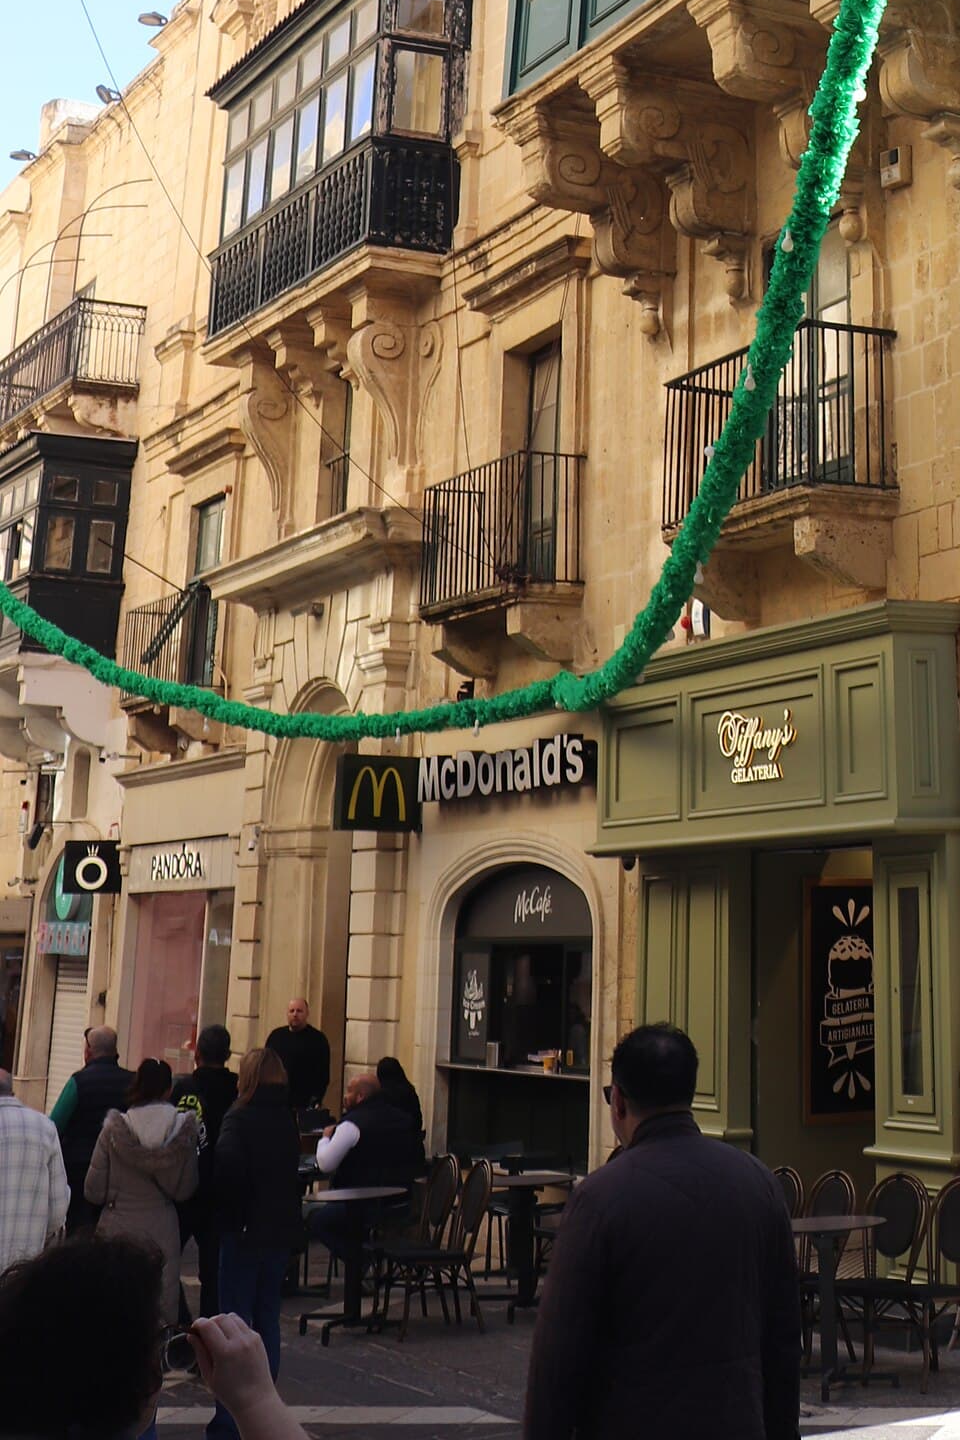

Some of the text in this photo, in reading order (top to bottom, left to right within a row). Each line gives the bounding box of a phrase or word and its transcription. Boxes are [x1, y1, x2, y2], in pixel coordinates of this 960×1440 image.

[717, 708, 796, 768] Tiffany's
[417, 734, 584, 803] McDonald's
[730, 763, 782, 783] GELATERIA
[150, 843, 204, 881] PANDORA
[514, 885, 552, 924] McCafé
[831, 997, 870, 1015] GELATERIA
